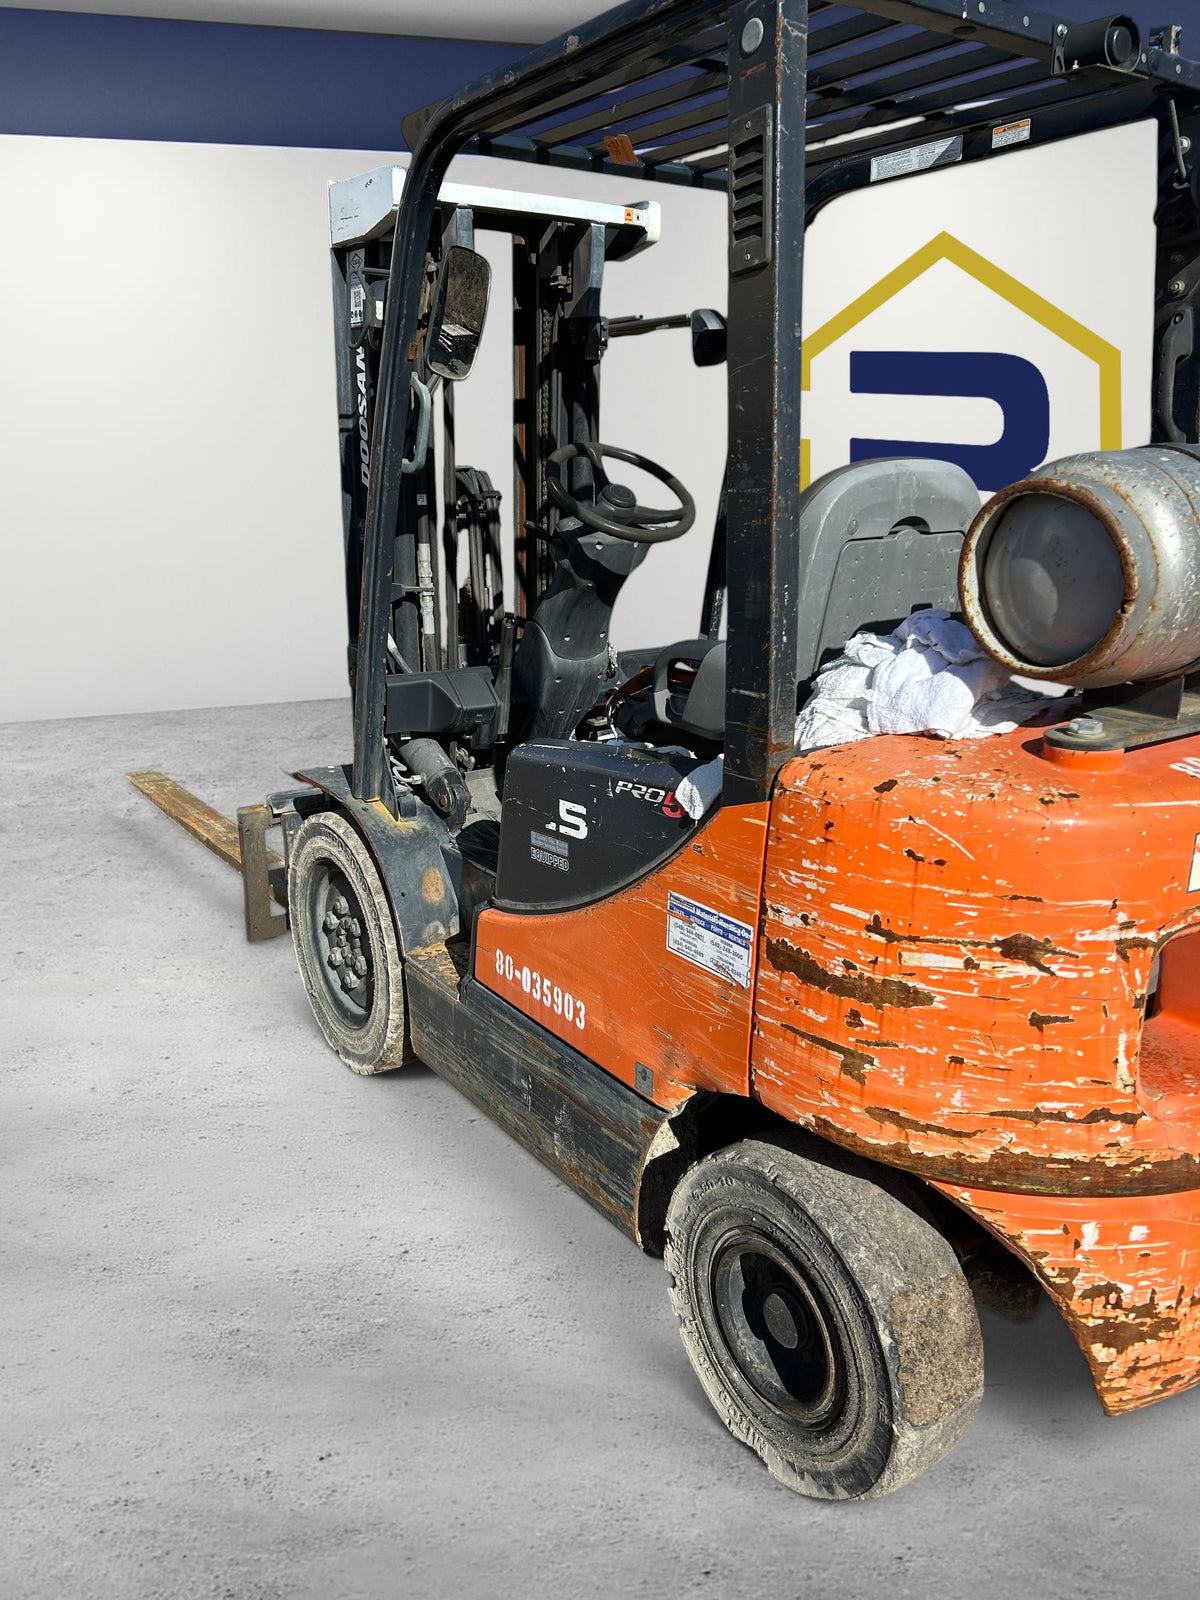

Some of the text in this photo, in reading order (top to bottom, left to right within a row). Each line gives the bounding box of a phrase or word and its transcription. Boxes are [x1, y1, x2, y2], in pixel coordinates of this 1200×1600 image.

[356, 346, 369, 488] DOOSAN
[530, 846, 570, 872] EQUIPPED
[495, 948, 585, 1030] 80-035903
